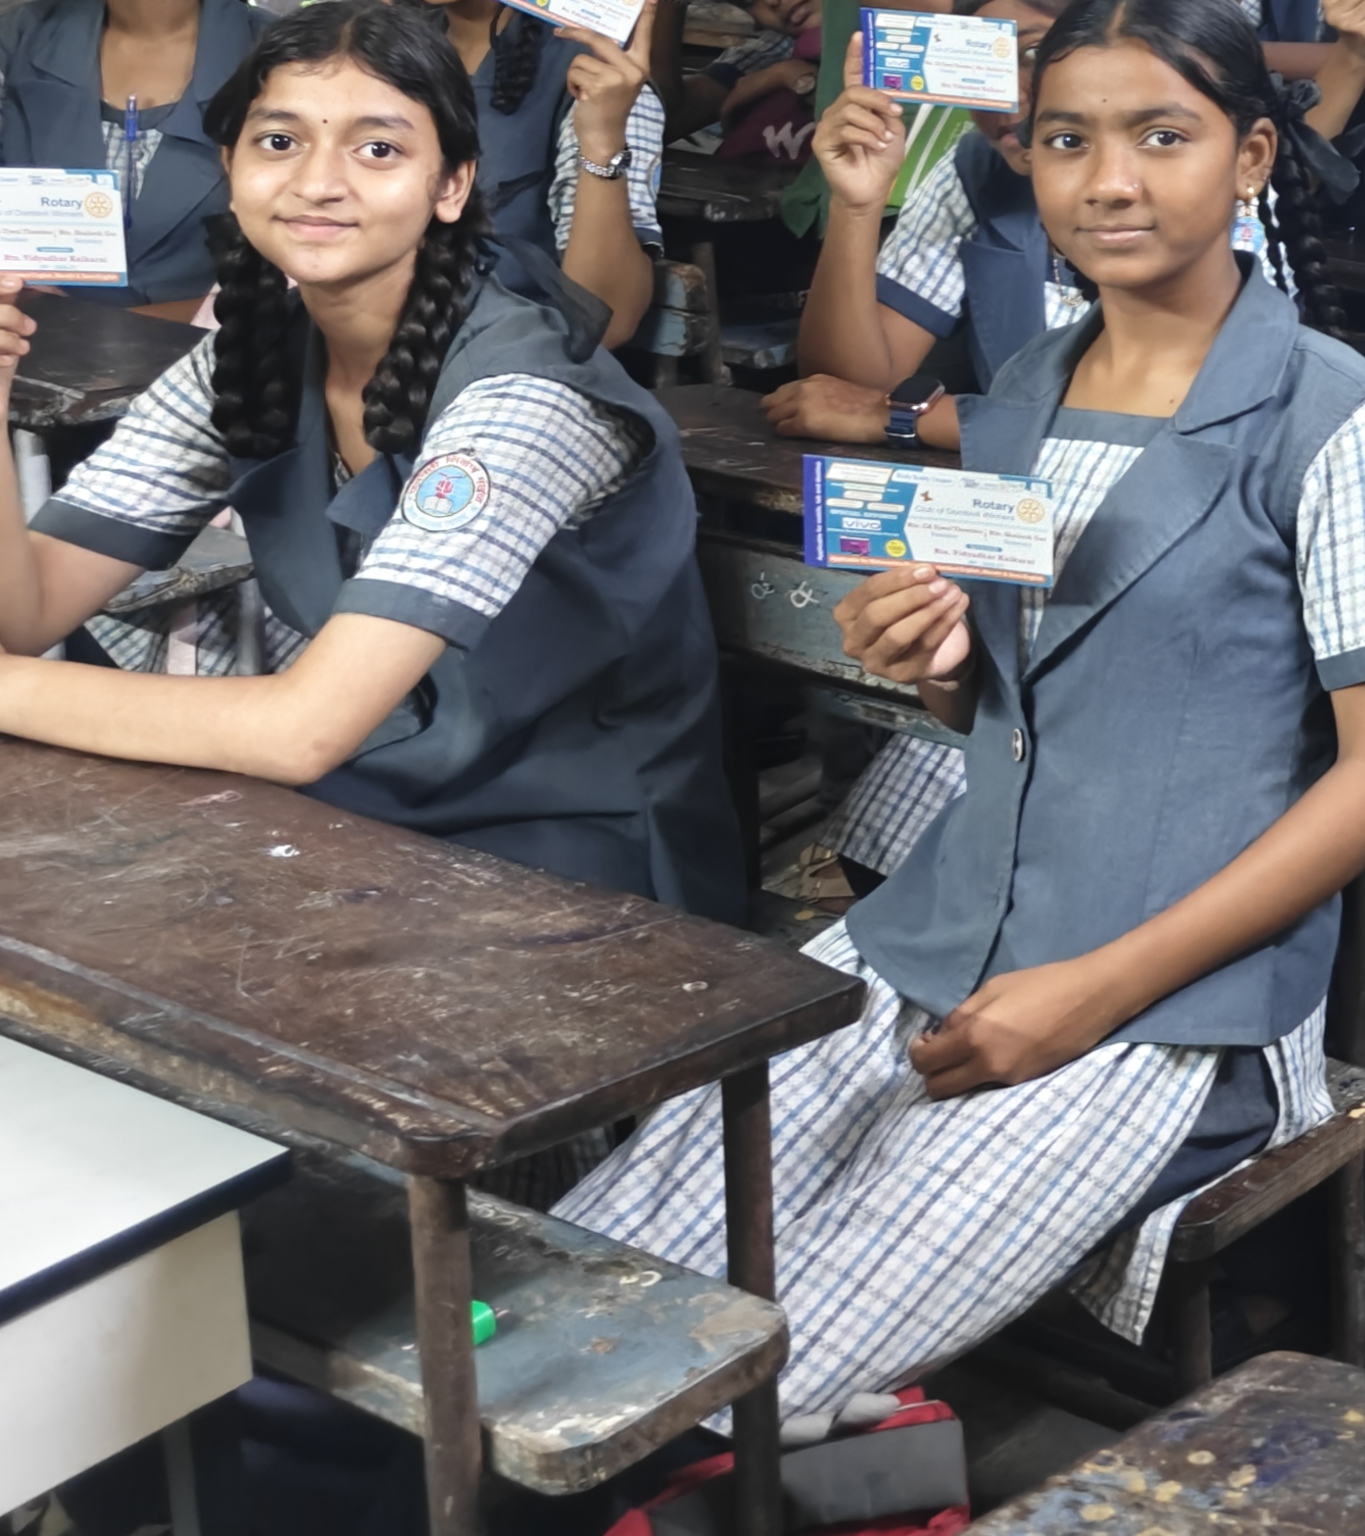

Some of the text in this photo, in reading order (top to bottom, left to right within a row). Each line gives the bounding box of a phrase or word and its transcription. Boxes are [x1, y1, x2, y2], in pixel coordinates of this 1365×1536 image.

[41, 197, 83, 209] Rotary
[972, 497, 1013, 512] Rotary
[845, 516, 880, 529] vivo
